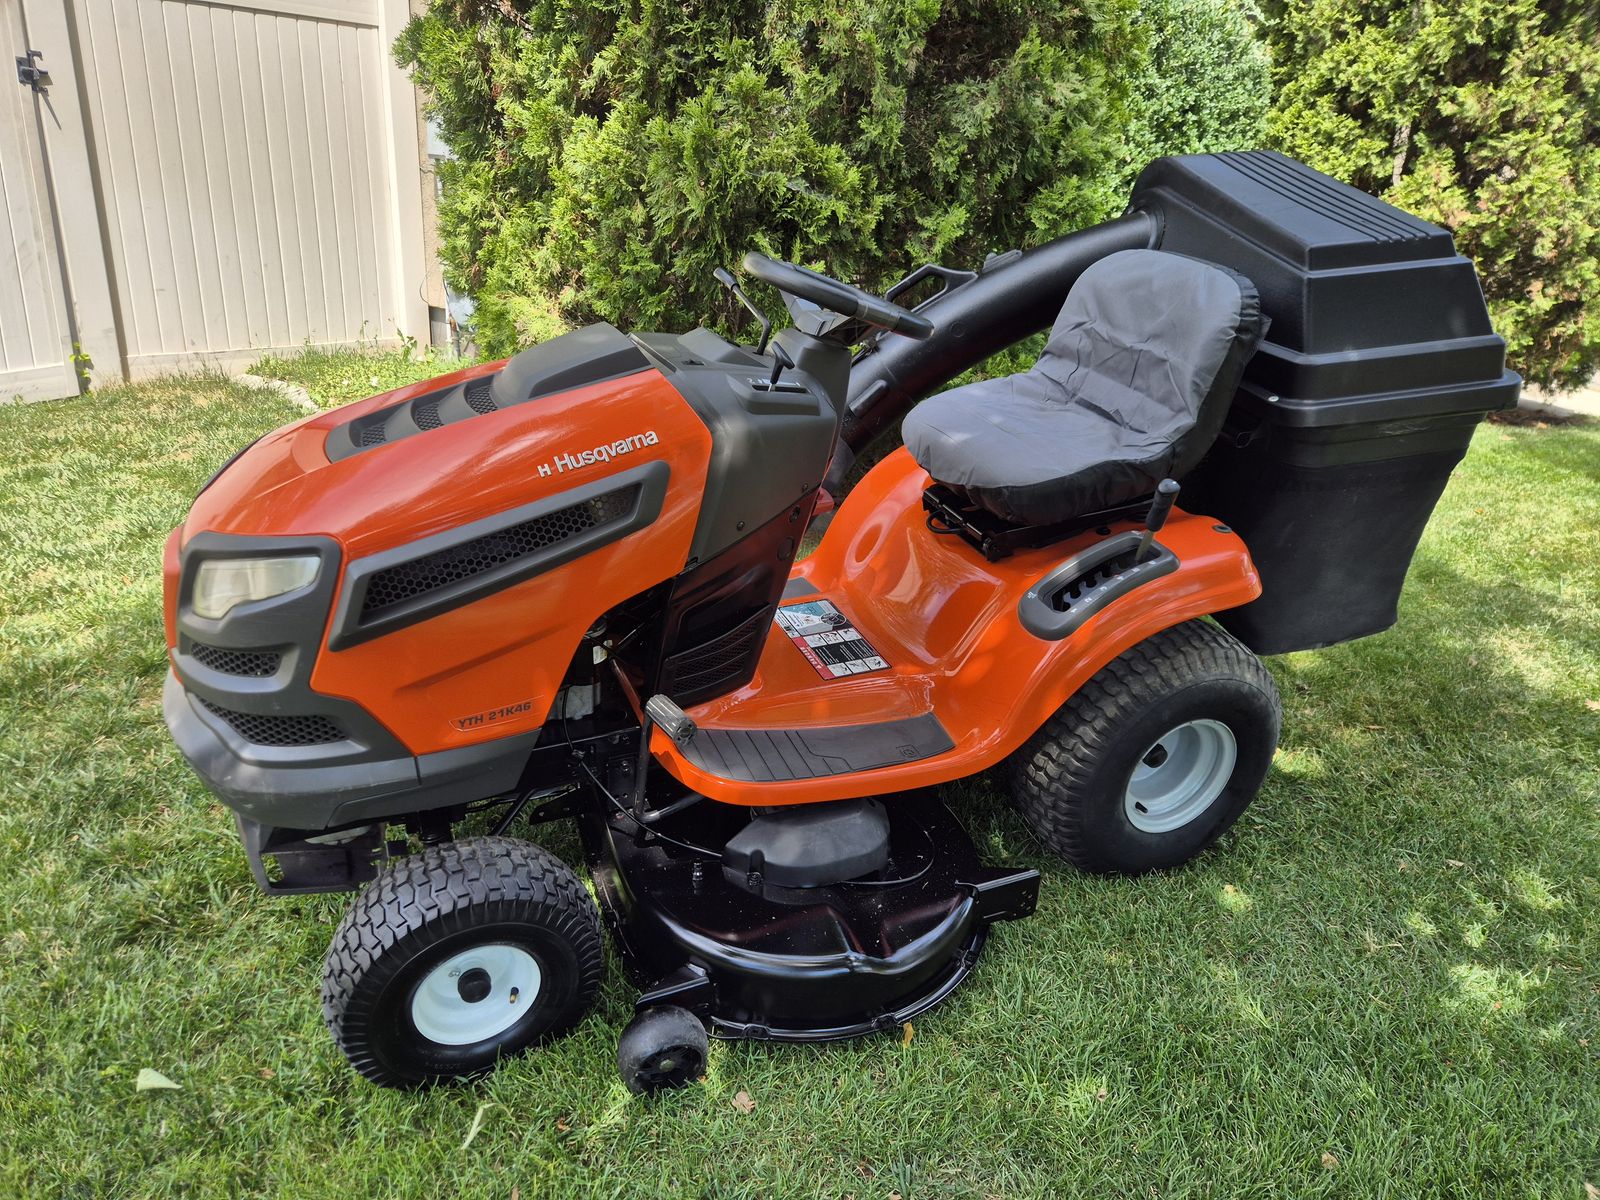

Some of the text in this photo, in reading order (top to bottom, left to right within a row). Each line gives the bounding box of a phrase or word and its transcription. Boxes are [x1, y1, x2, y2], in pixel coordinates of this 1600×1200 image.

[554, 430, 659, 473] Husqvarna
[458, 702, 532, 728] YTH 21K46
